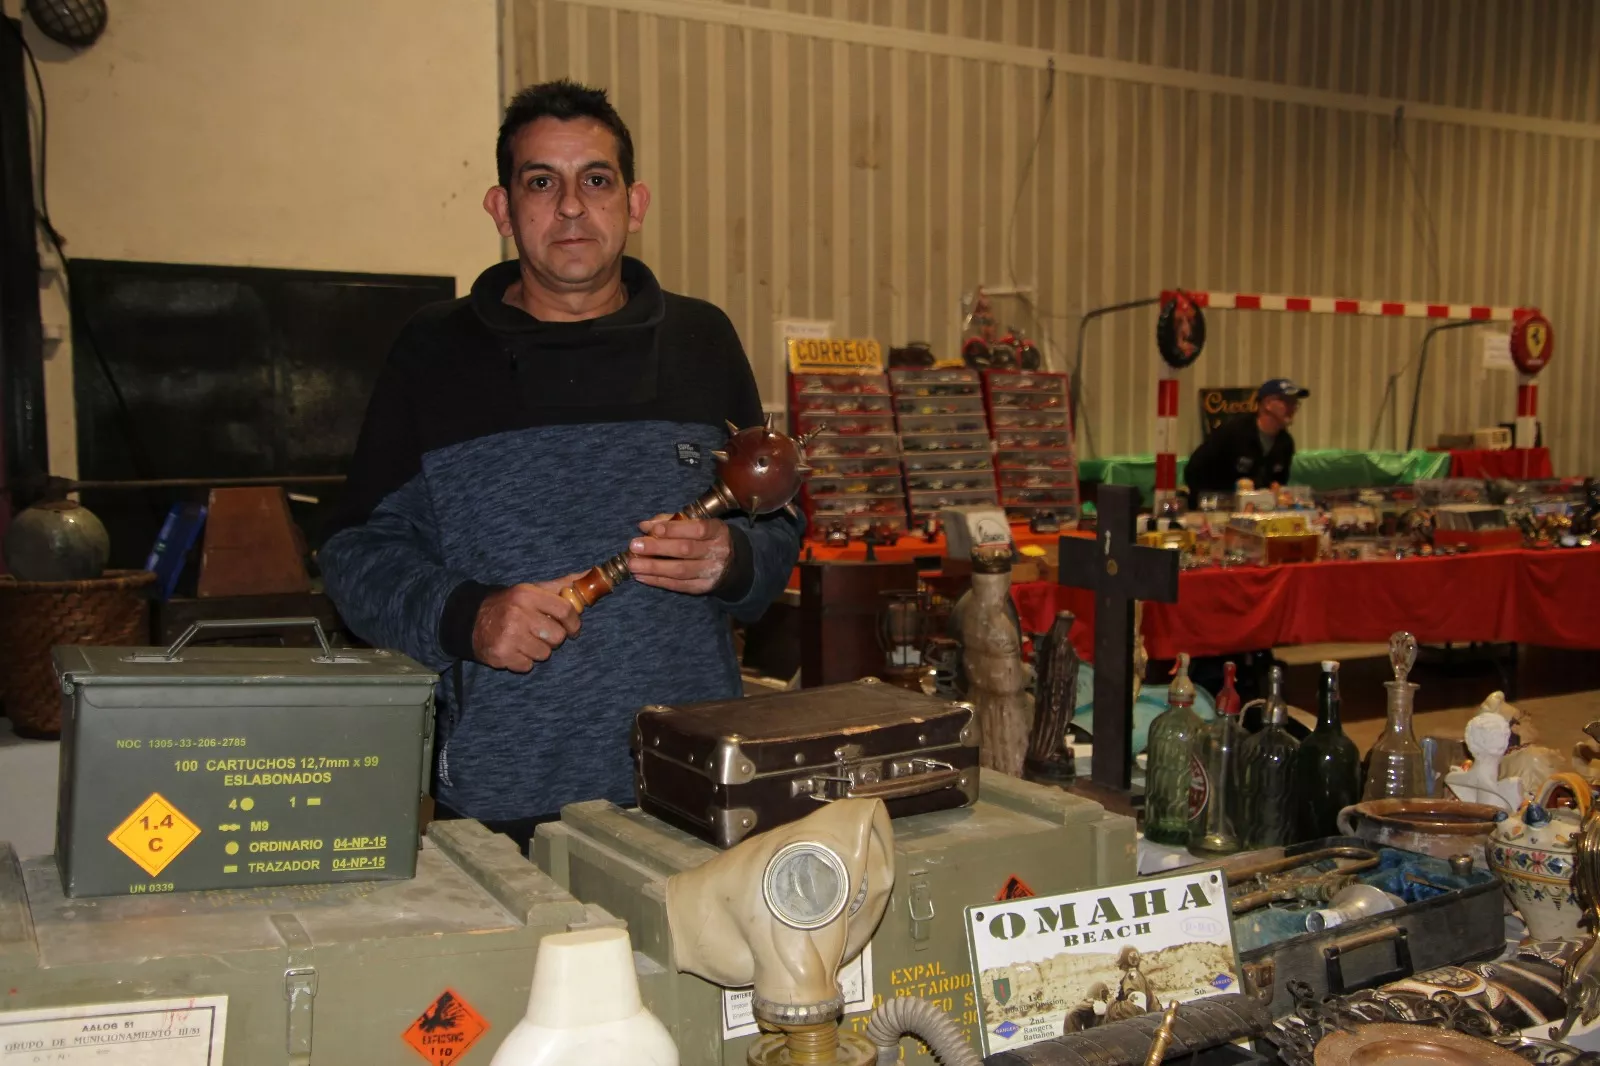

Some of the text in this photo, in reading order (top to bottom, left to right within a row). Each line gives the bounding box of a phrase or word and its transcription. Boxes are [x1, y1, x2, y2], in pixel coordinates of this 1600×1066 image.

[117, 739, 246, 748] NOC 1305-33-206-2785
[175, 756, 379, 771] 100 CARTUCHOS 12,7mm x 99
[224, 773, 332, 786] ESLABONADOS
[228, 799, 237, 810] 4
[289, 797, 297, 808] 1
[140, 814, 173, 830] 1.4
[250, 821, 269, 832] M9
[148, 837, 163, 852] C
[249, 836, 387, 853] ORDINARIO 04-NP-15
[248, 856, 386, 873] TRAZADOR 04-NP-15
[129, 883, 174, 893] UN 0339
[989, 882, 1213, 940] OMAHA
[1063, 922, 1151, 947] BEACH
[891, 961, 946, 985] EXPAL
[1029, 1017, 1045, 1026] 2nd
[1023, 1024, 1053, 1035] Rangers
[1023, 1031, 1055, 1041] Battalion
[52, 1039, 66, 1047] DE
[74, 1030, 171, 1045] MUNICIONAMIENTO
